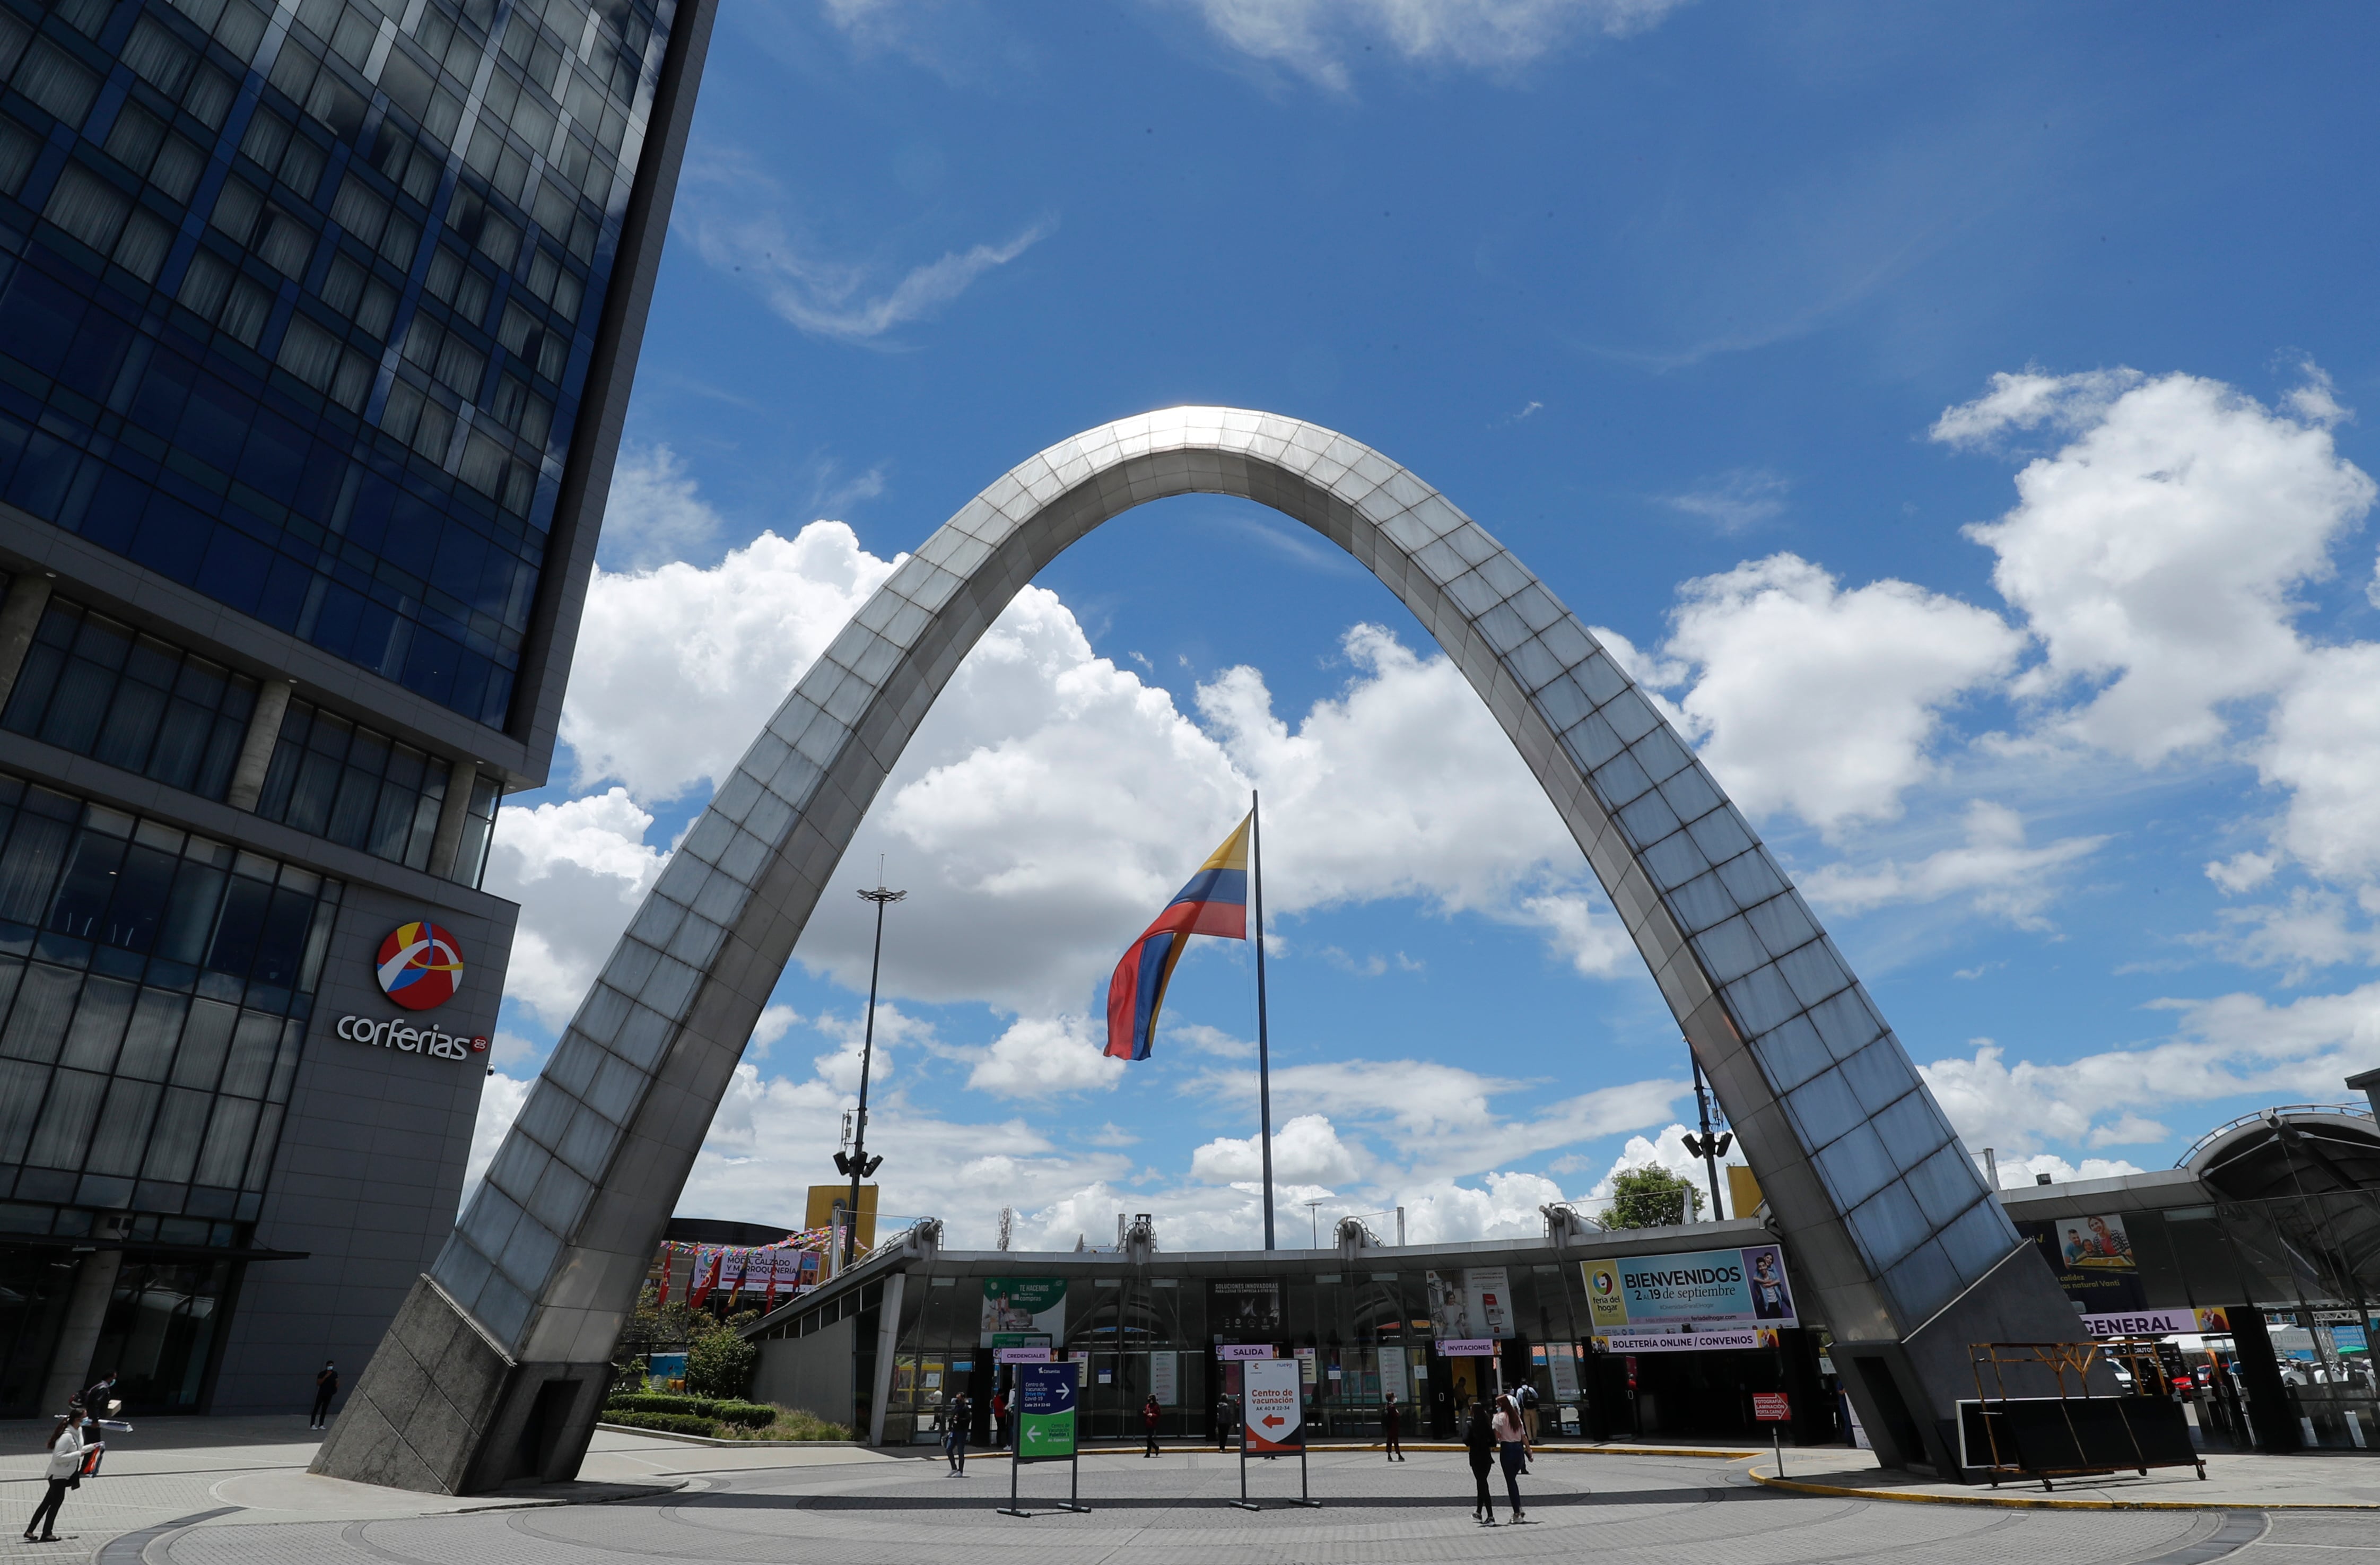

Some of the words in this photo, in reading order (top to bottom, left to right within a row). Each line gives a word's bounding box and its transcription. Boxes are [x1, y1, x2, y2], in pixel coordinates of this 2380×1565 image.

[337, 1015, 470, 1060] corferias
[755, 1258, 790, 1266] CALZADO
[733, 1265, 797, 1275] MRROQUNERÍA
[1624, 1266, 1741, 1289] BIENVENIDOS
[1634, 1290, 1642, 1300] 2
[1650, 1290, 1661, 1300] 19
[1663, 1287, 1675, 1299] de
[1677, 1284, 1736, 1301] septiembre
[1597, 1305, 1618, 1313] hogar
[2082, 1316, 2179, 1334] GENERAL
[1612, 1337, 1658, 1348] BOLETERÍA
[1660, 1337, 1692, 1347] ONLINE
[1699, 1335, 1753, 1345] CONVENIOS
